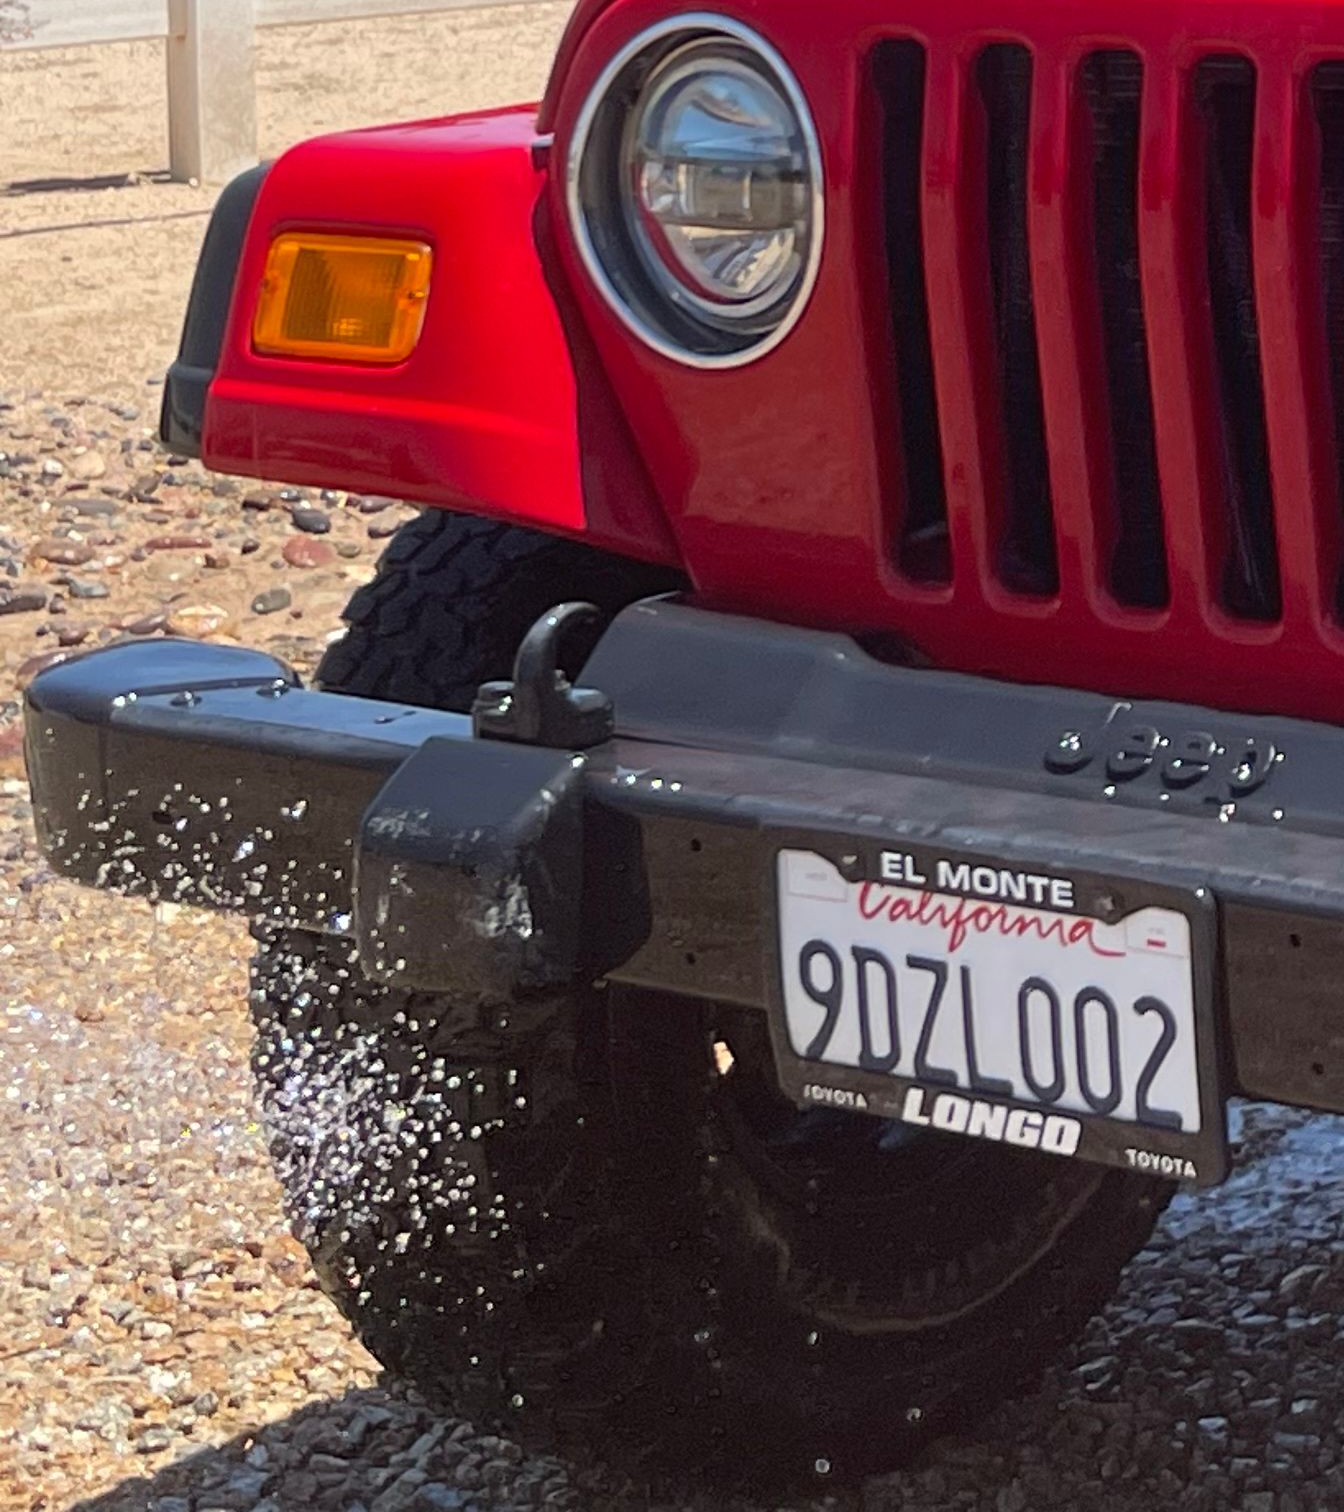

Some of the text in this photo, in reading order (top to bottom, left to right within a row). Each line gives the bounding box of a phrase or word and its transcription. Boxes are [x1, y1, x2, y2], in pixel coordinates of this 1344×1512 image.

[1044, 701, 1278, 804] Jeep
[880, 851, 1075, 908] EL MONTE
[858, 881, 1127, 957] California
[799, 939, 1182, 1131] 9DZL002
[902, 1087, 1082, 1156] LONGO
[1125, 1148, 1197, 1179] TOYOTA
